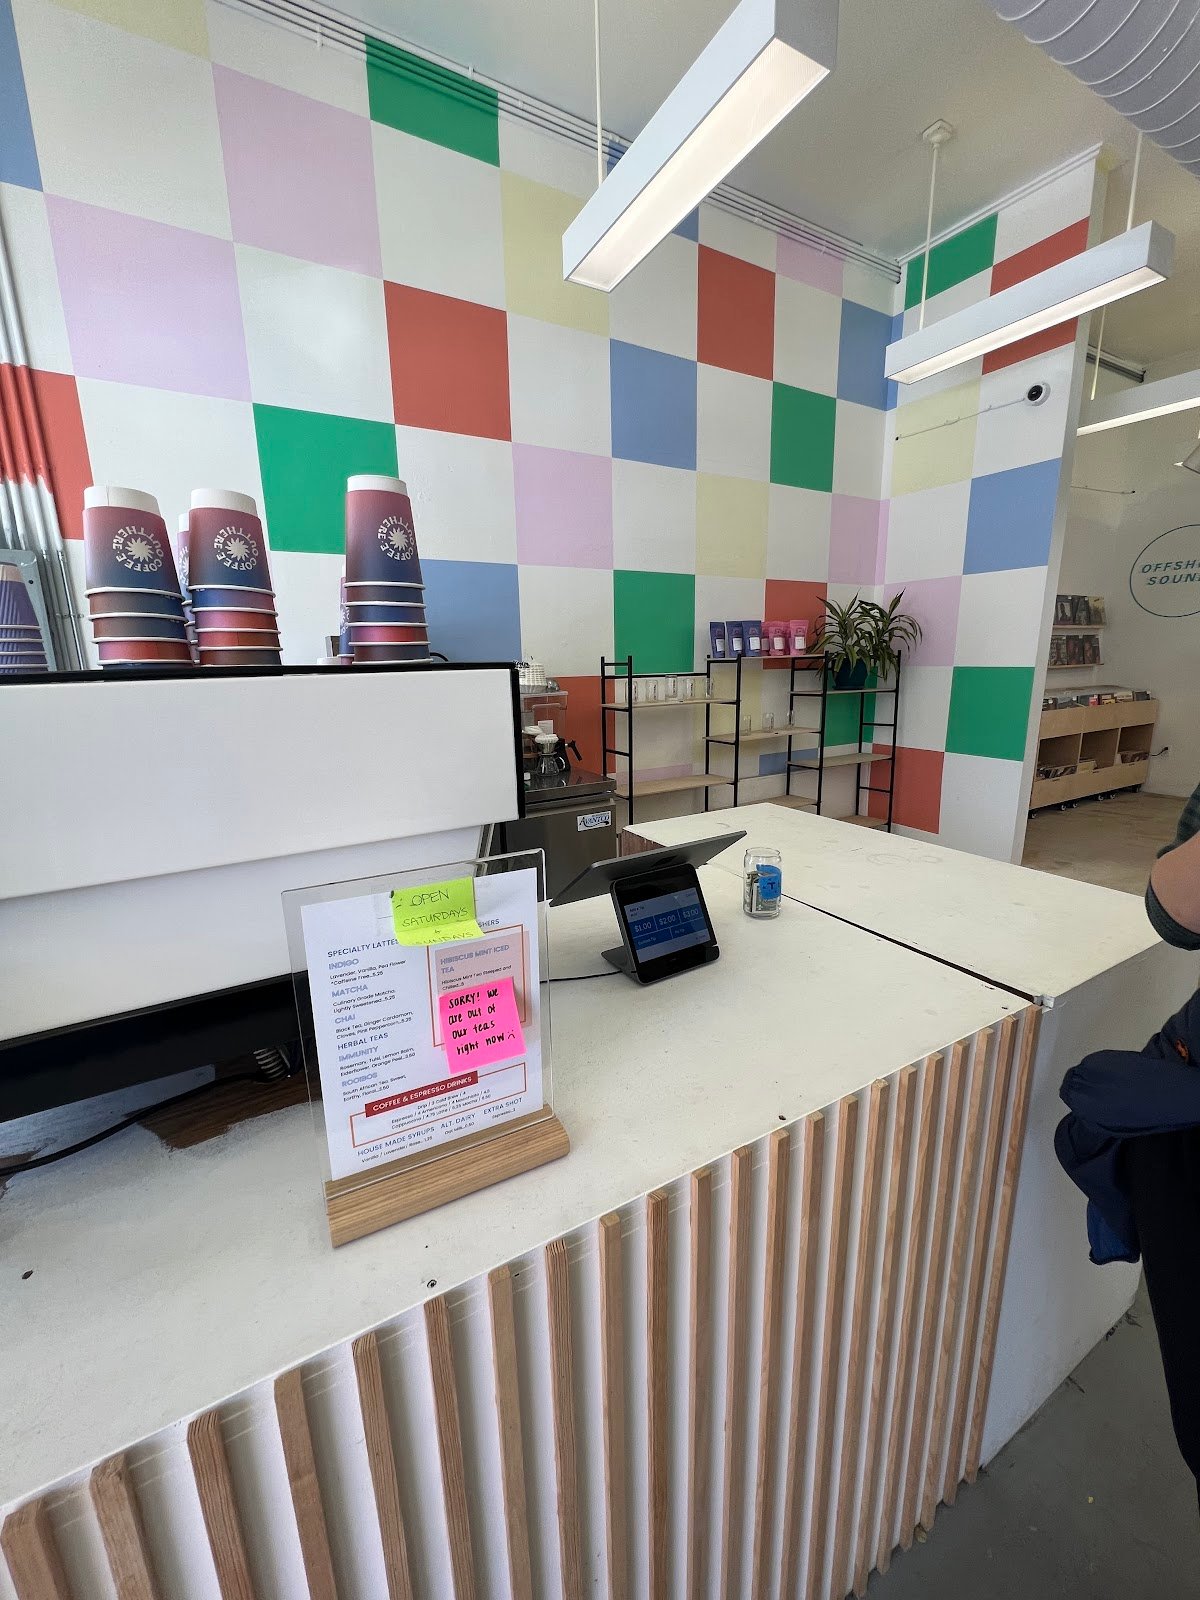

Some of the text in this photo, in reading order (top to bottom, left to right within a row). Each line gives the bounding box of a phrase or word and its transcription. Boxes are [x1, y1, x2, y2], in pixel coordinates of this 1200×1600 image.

[378, 516, 415, 546] OUT THERE
[112, 525, 164, 558] OUT THERE
[214, 526, 259, 557] OUT THERE
[380, 542, 413, 560] COFFEE
[116, 552, 162, 572] COFFEE
[216, 551, 257, 571] COFFEE
[410, 890, 450, 906] OPEN
[634, 908, 699, 932] $1.00 $2.00 $3.00
[327, 943, 370, 958] SPECIALTY
[440, 944, 509, 964] HIBISCUS MINT ICED
[328, 957, 359, 970] INDIGO
[441, 965, 454, 974] TEA
[331, 983, 368, 997] MATCHA
[332, 997, 355, 1007] Culinary
[356, 993, 374, 1001] Grade
[333, 1004, 351, 1013] Lightly
[449, 991, 480, 1009] SORRY!
[334, 1013, 355, 1024] CHAI
[448, 1003, 496, 1026] are out of
[452, 1020, 495, 1040] our teas
[337, 1031, 388, 1050] HERBAL TEAS
[457, 1033, 504, 1055] right now
[338, 1045, 379, 1062] IMMUNITY
[341, 1071, 377, 1087] ROOIBOS
[372, 1097, 400, 1111] COFFEE
[410, 1083, 445, 1100] ESPRESSO
[446, 1075, 472, 1089] DRINKS
[483, 1096, 522, 1115] EXTRA SHOT
[440, 1112, 475, 1129] ALT. DAIRY
[357, 1126, 434, 1156] HOUSE MADE SYRUPS
